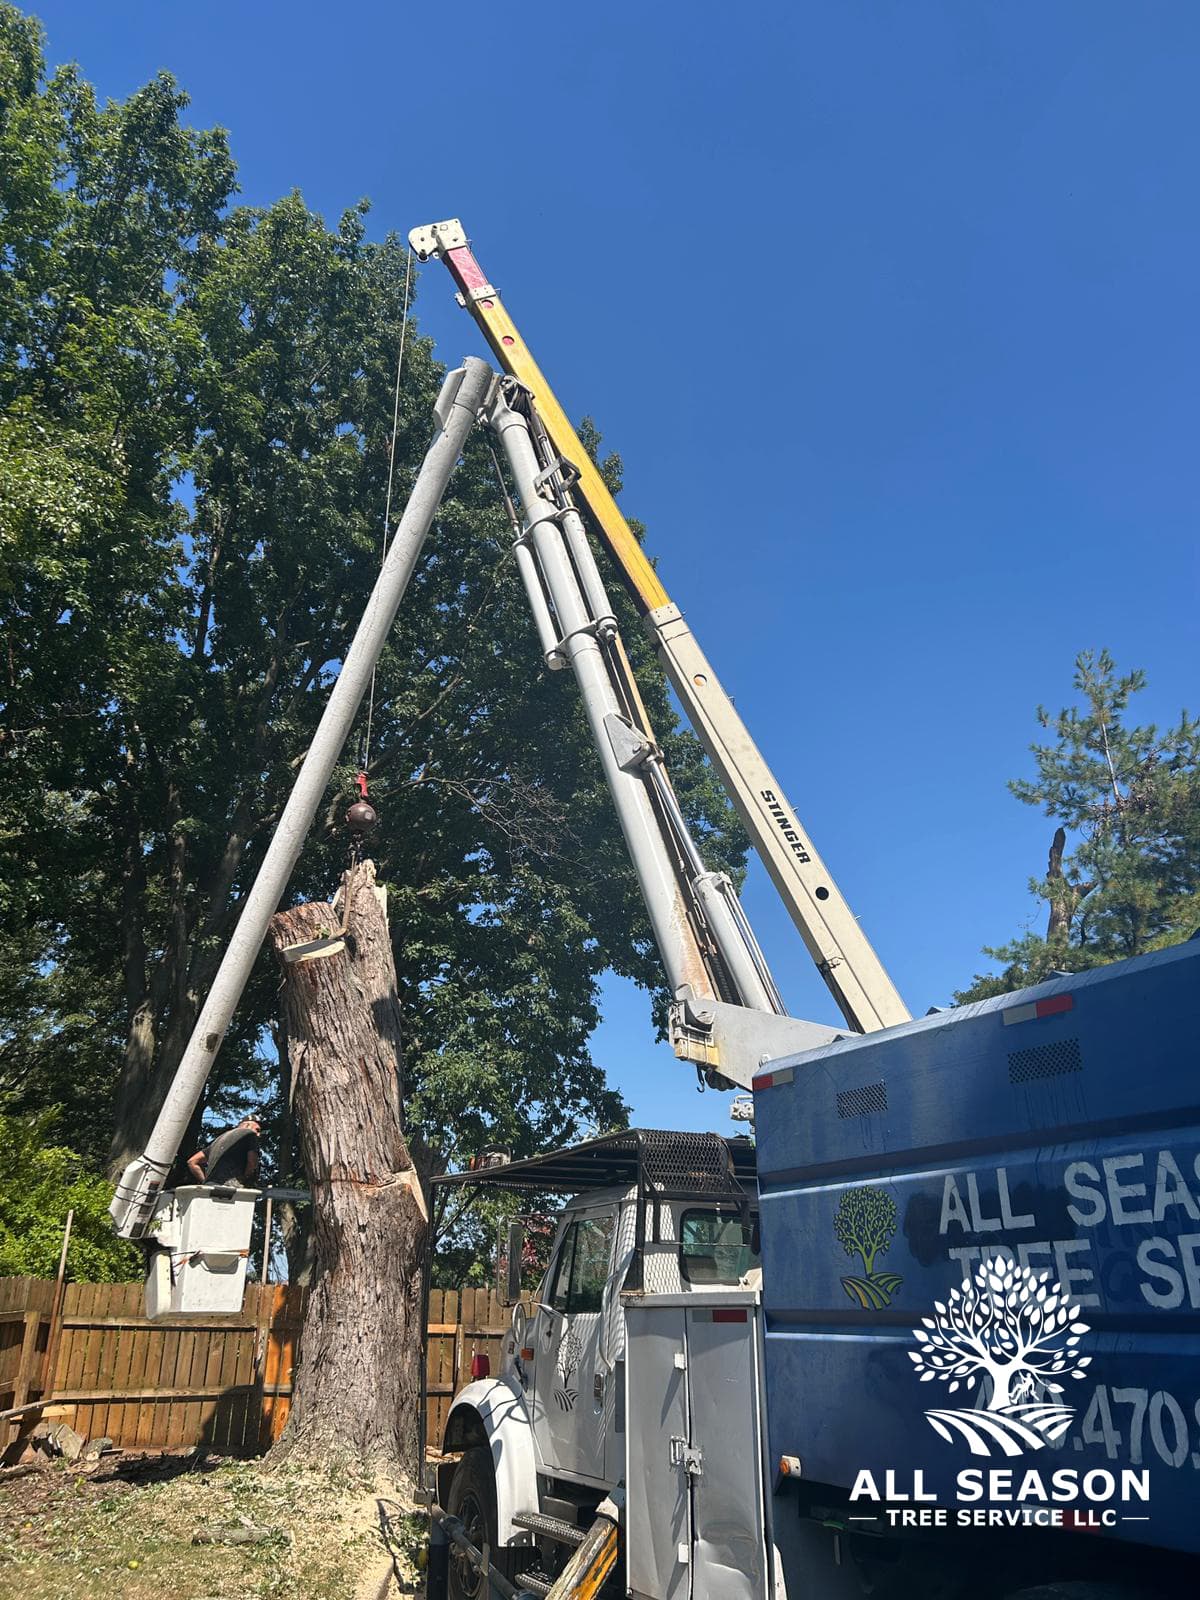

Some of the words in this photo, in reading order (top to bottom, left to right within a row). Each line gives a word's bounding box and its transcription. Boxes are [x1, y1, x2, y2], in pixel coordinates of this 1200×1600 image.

[760, 789, 811, 864] STINGER
[939, 1167, 1036, 1235] ALL
[1064, 1150, 1200, 1227] SEA
